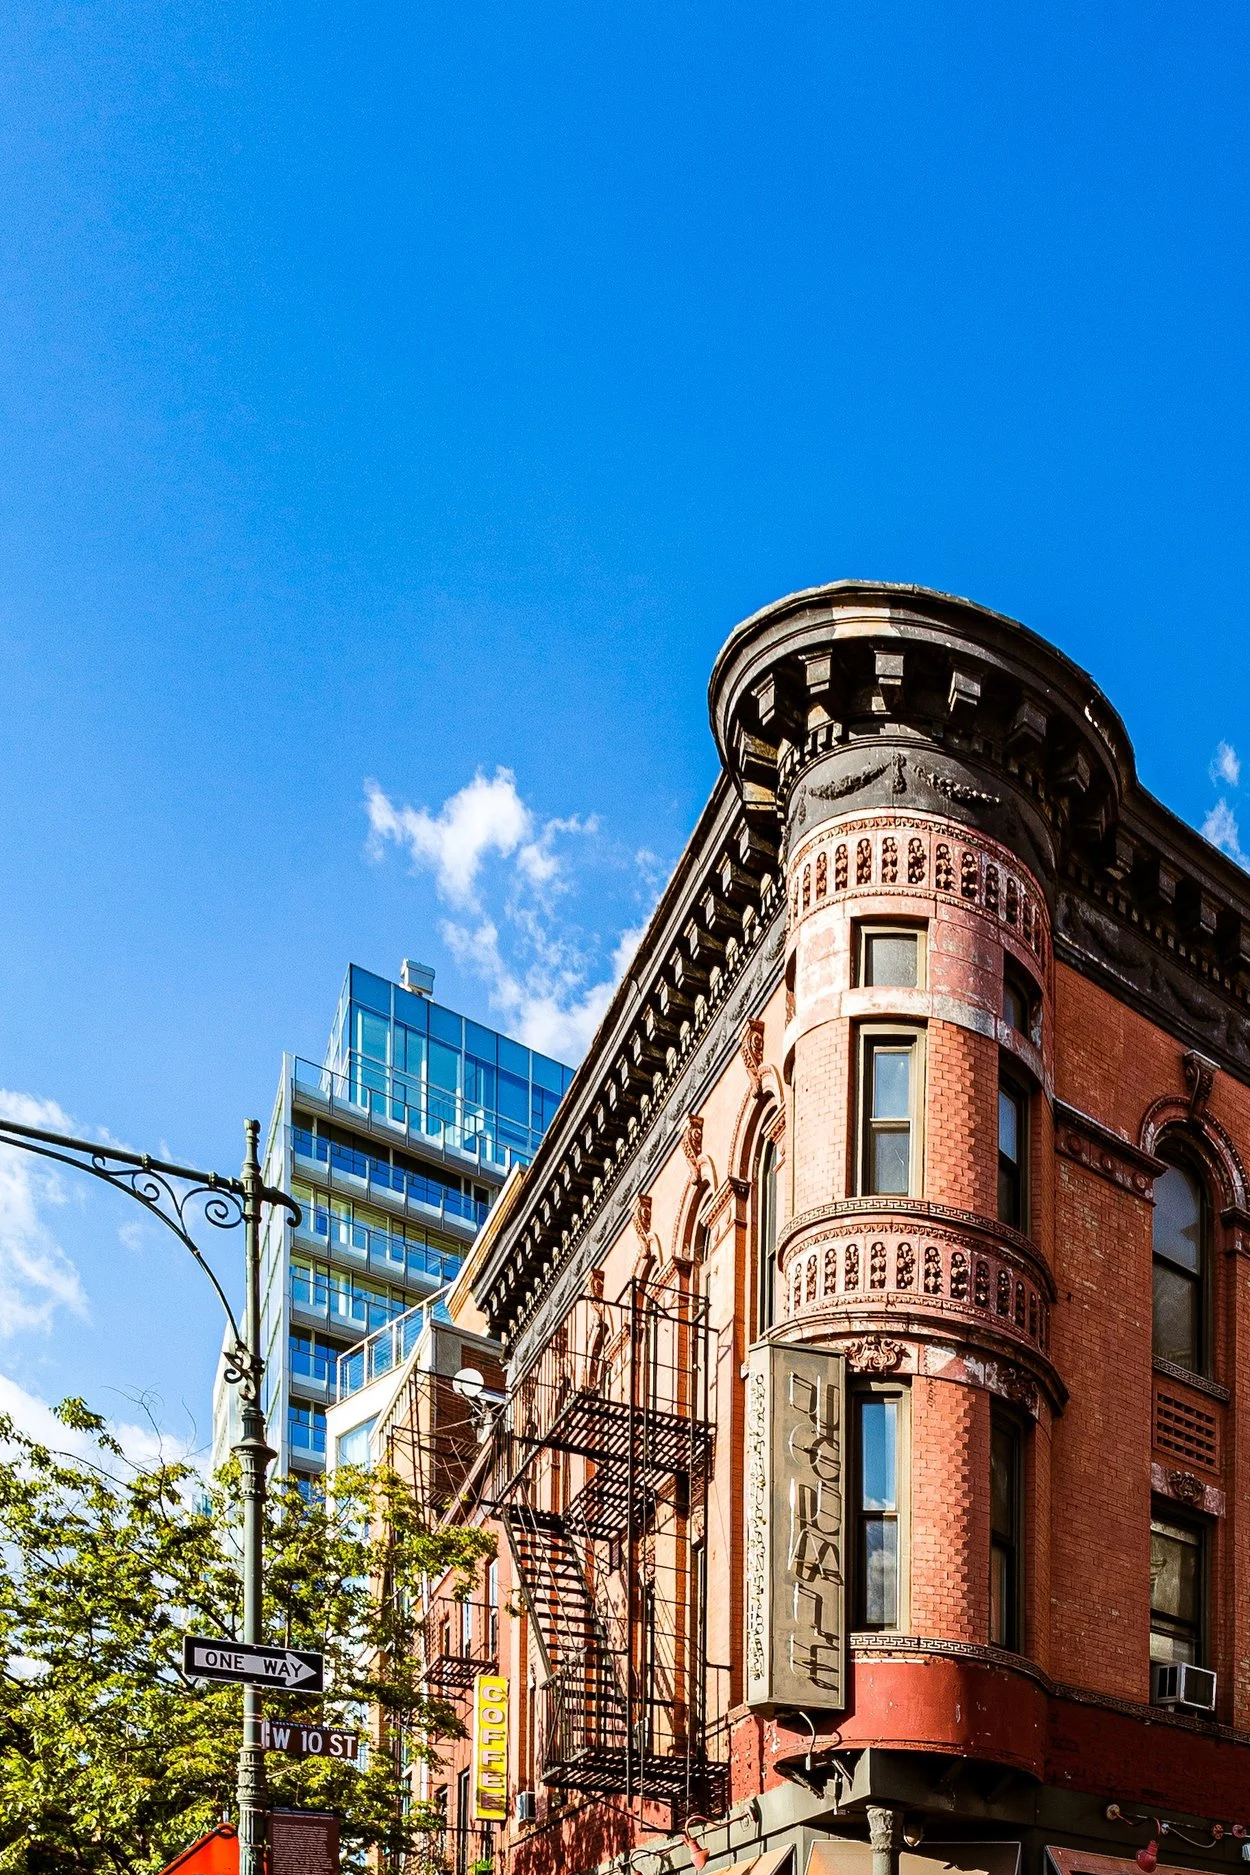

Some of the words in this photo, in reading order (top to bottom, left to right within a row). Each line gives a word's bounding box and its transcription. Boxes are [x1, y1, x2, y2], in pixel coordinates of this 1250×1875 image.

[205, 1651, 245, 1671] ONE
[263, 1658, 304, 1678] WAY
[272, 1727, 291, 1750] W
[301, 1730, 323, 1754] 10
[329, 1733, 357, 1758] ST
[482, 1685, 506, 1810] COFFEE
